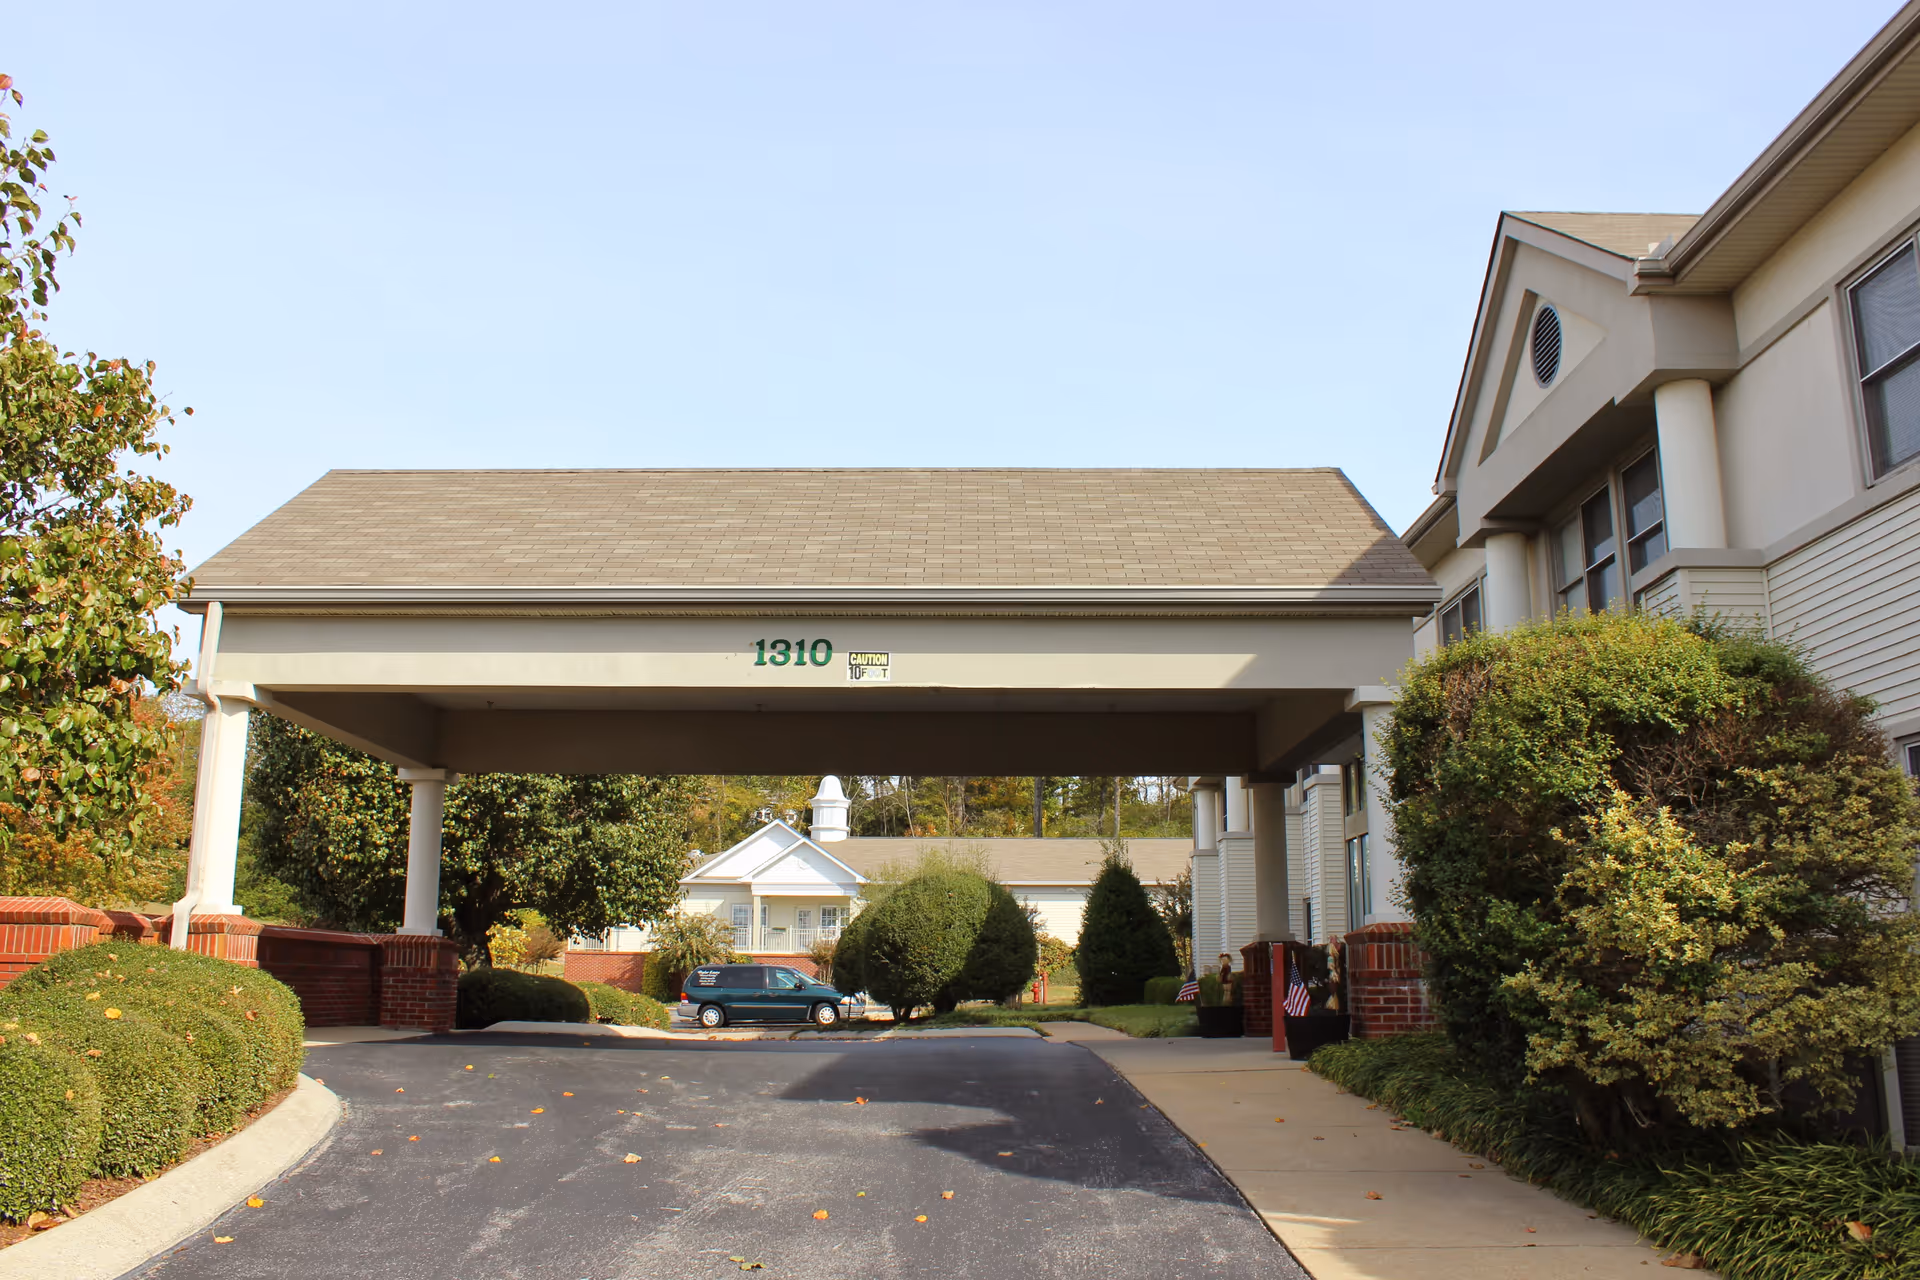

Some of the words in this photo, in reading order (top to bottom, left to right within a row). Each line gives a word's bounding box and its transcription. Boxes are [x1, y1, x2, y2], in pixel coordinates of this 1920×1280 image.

[754, 638, 832, 666] 1310
[850, 652, 888, 665] CAUTION
[849, 665, 861, 680] 10
